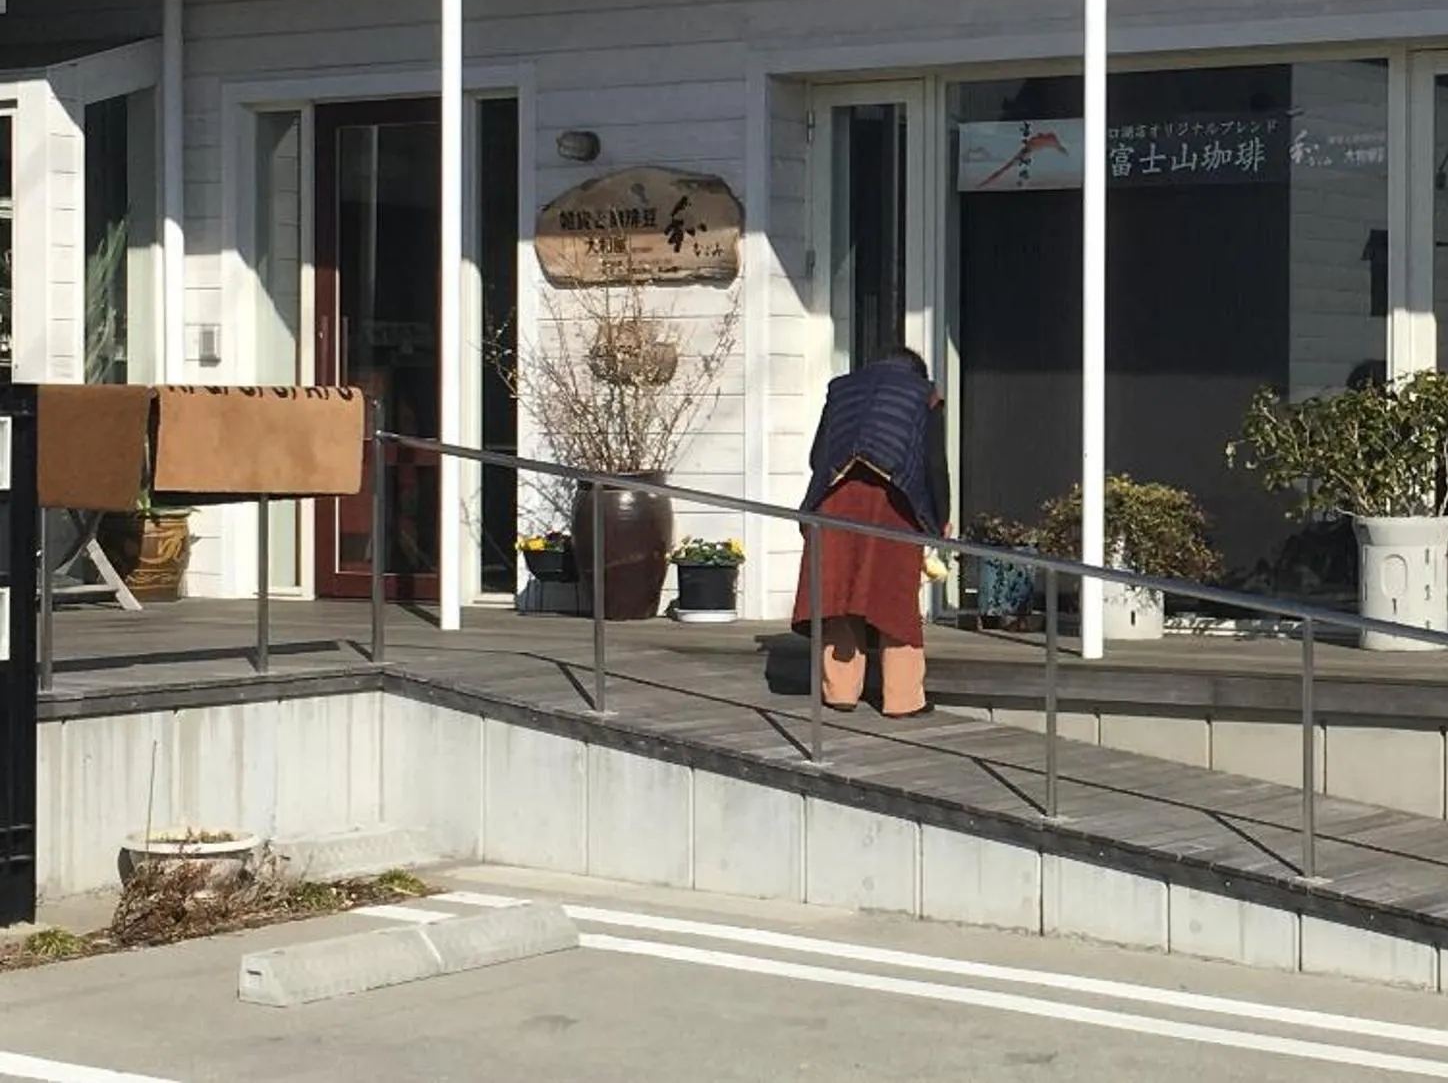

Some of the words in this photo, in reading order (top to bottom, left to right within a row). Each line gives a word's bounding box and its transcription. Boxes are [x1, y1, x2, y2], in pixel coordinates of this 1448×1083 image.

[1109, 137, 1266, 177] 富士山珈琲
